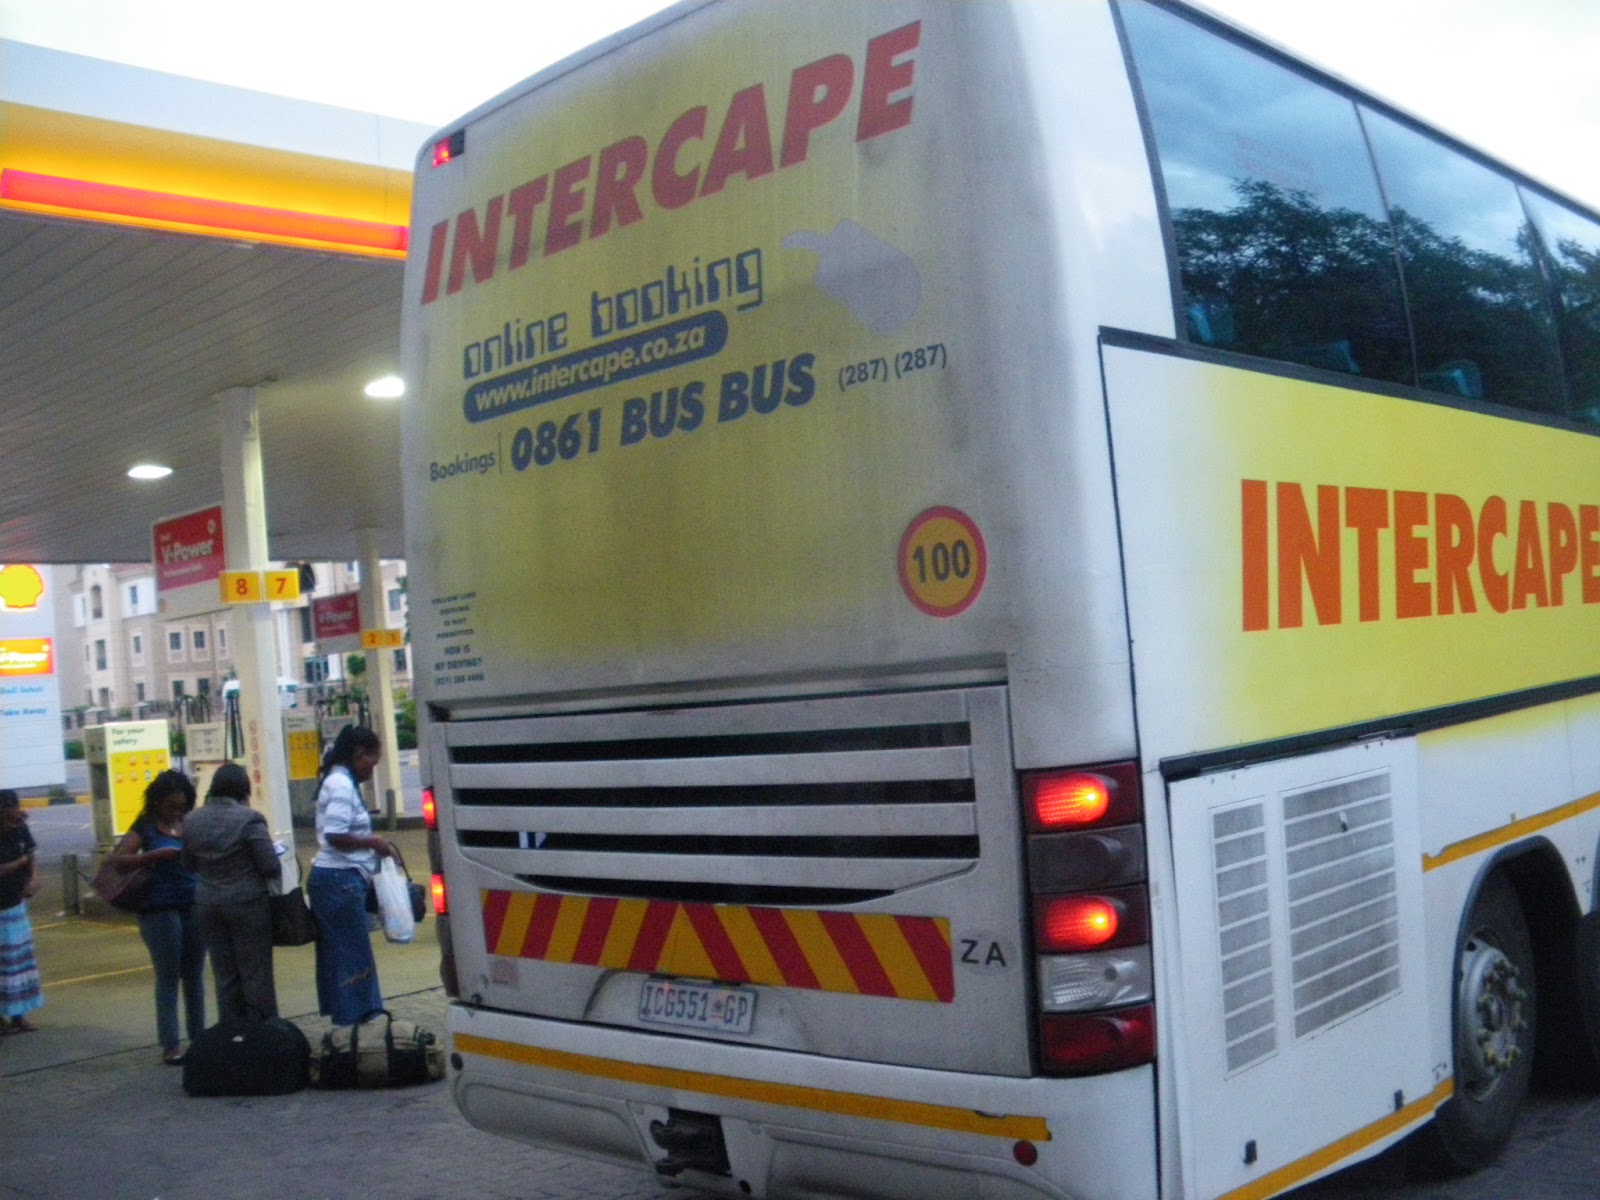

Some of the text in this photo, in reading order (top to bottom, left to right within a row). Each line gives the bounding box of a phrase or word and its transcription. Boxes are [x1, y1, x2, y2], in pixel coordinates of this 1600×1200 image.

[421, 20, 921, 306] INTERCAPE
[463, 248, 763, 379] online booking
[475, 325, 708, 412] www.intercape.co.za
[429, 343, 948, 482] Bookings 0861 BUS BUS (287) (287)
[236, 578, 248, 595] 8
[276, 577, 287, 594] 7
[913, 540, 971, 583] 100
[1241, 478, 1600, 632] INTERCAPE
[961, 939, 1007, 967] ZA
[724, 995, 748, 1026] GP
